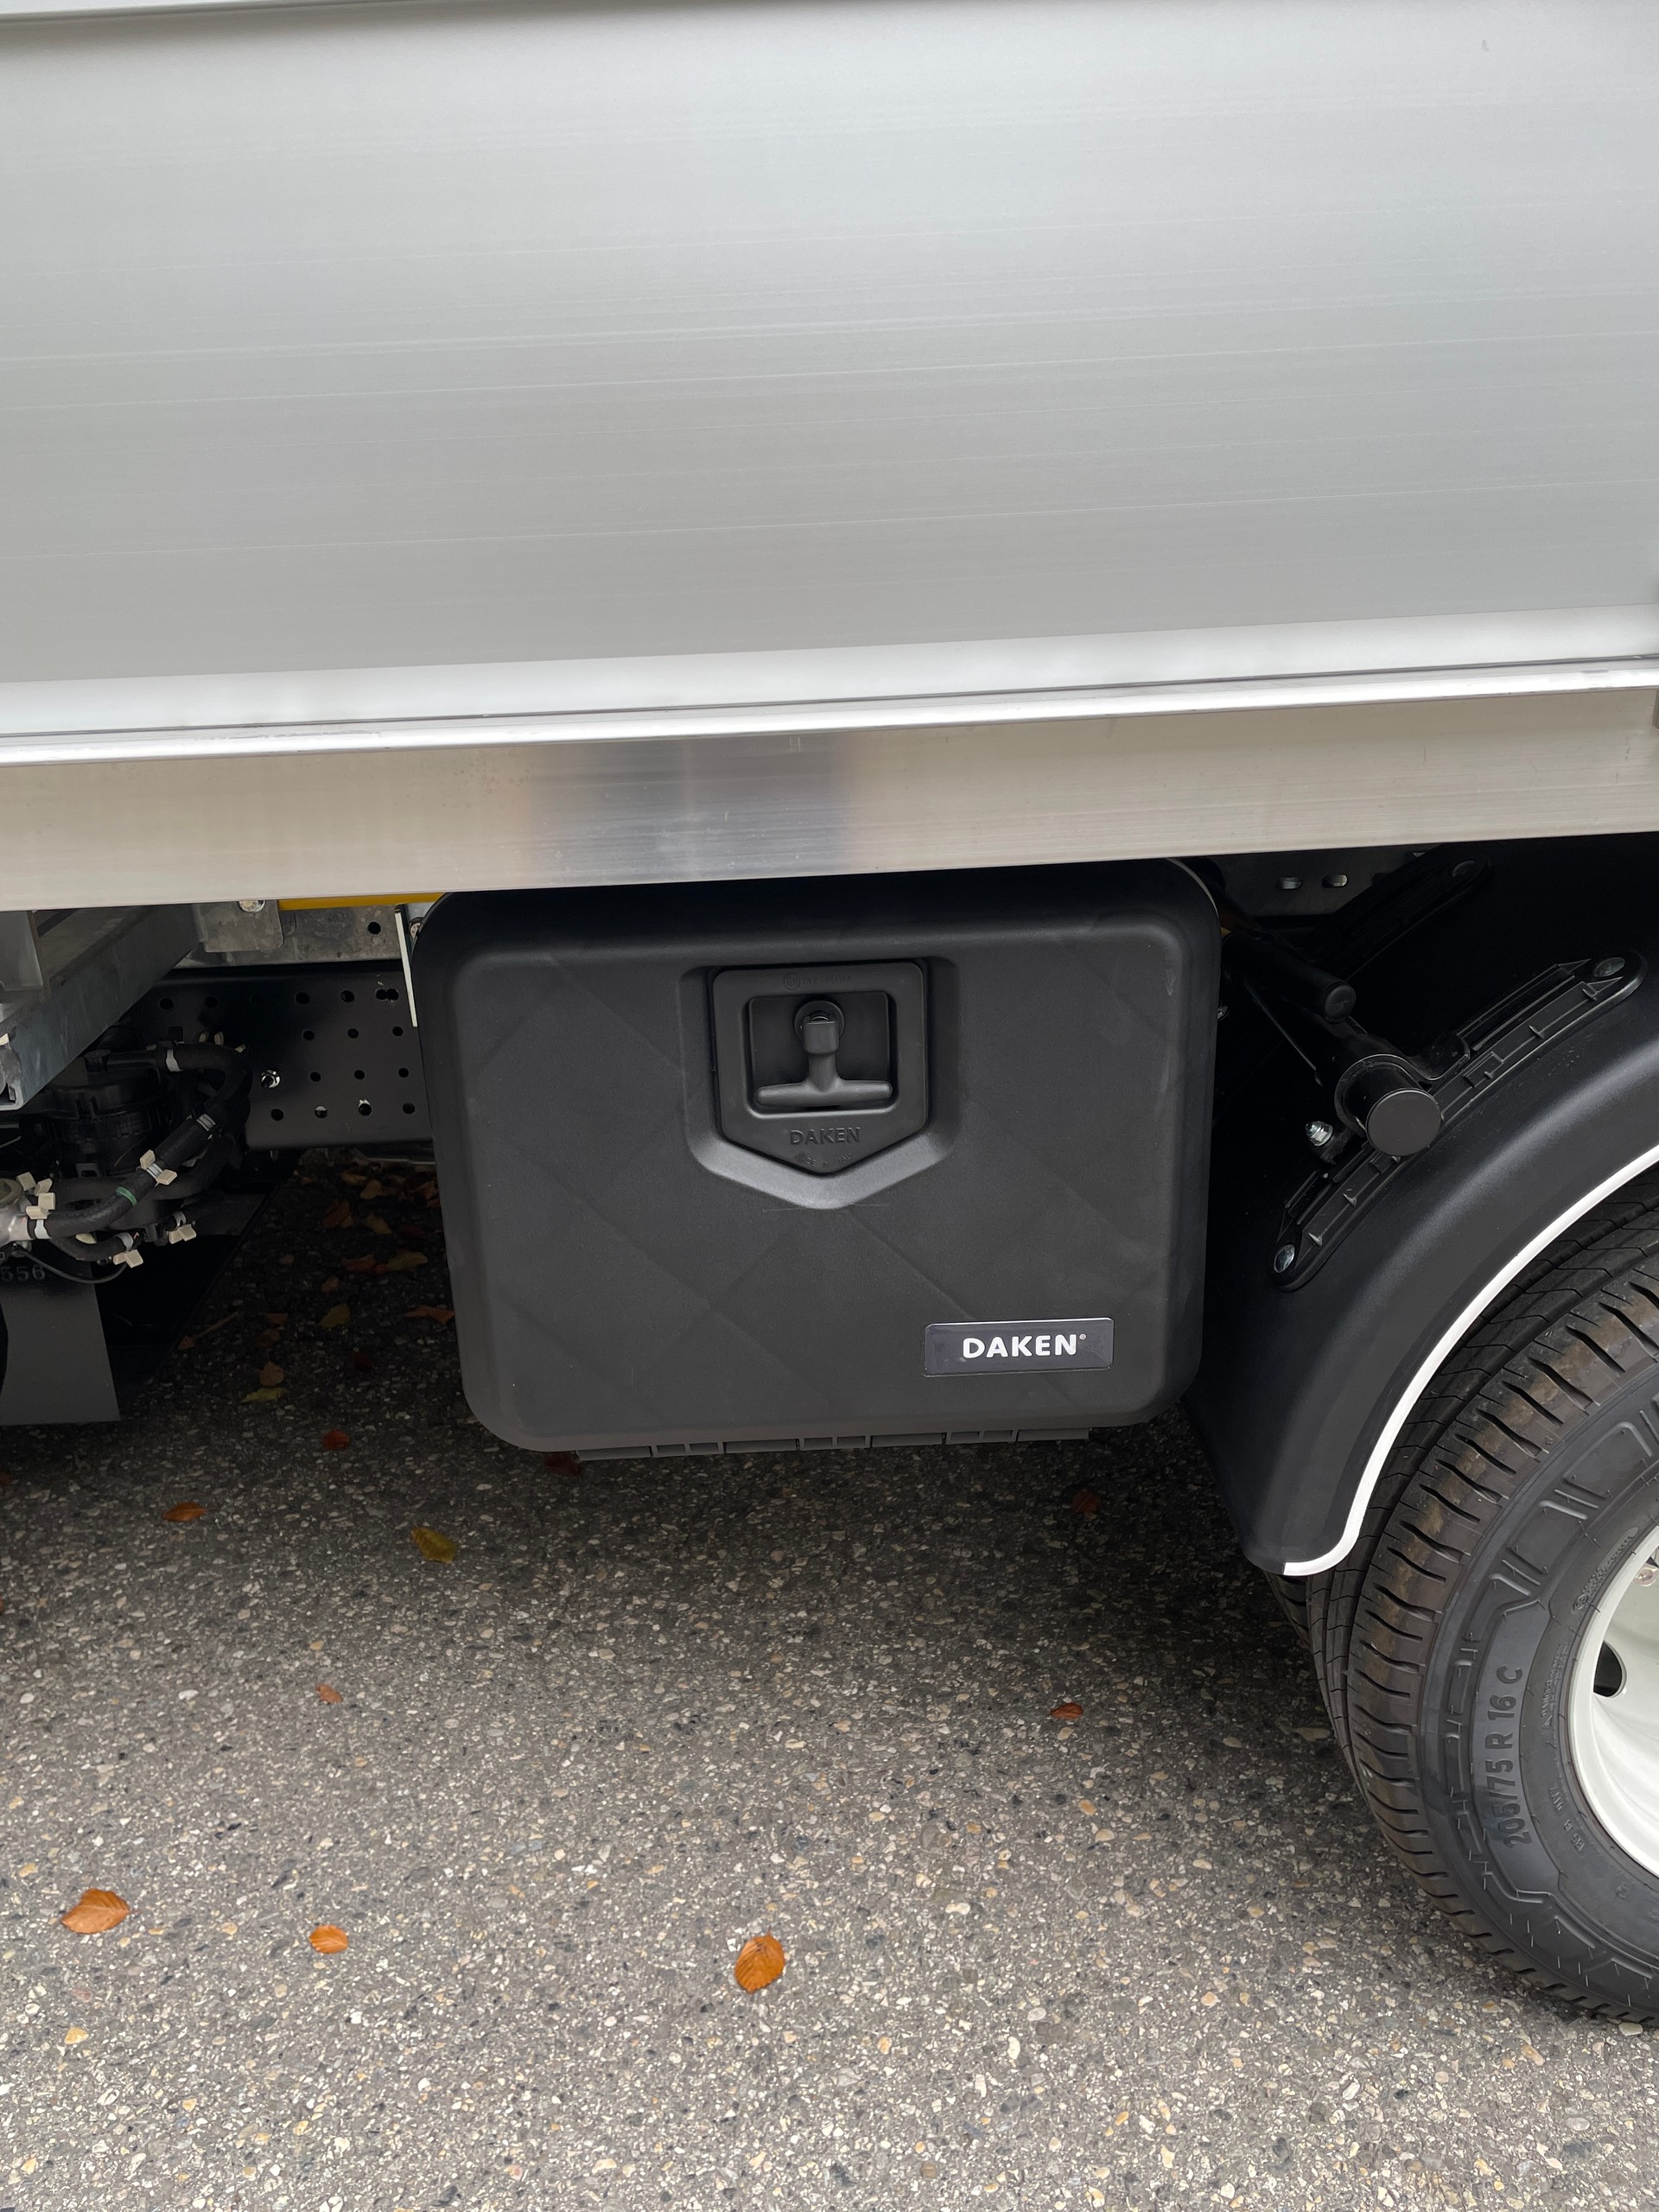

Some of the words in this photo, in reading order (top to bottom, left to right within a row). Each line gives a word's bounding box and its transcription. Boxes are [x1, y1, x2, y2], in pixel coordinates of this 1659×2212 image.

[790, 1126, 861, 1146] DAKEN
[1496, 1663, 1523, 1685] C
[1487, 1694, 1516, 1721] 16
[1484, 1732, 1514, 1749] R
[1485, 1758, 1533, 1849] 205/75
